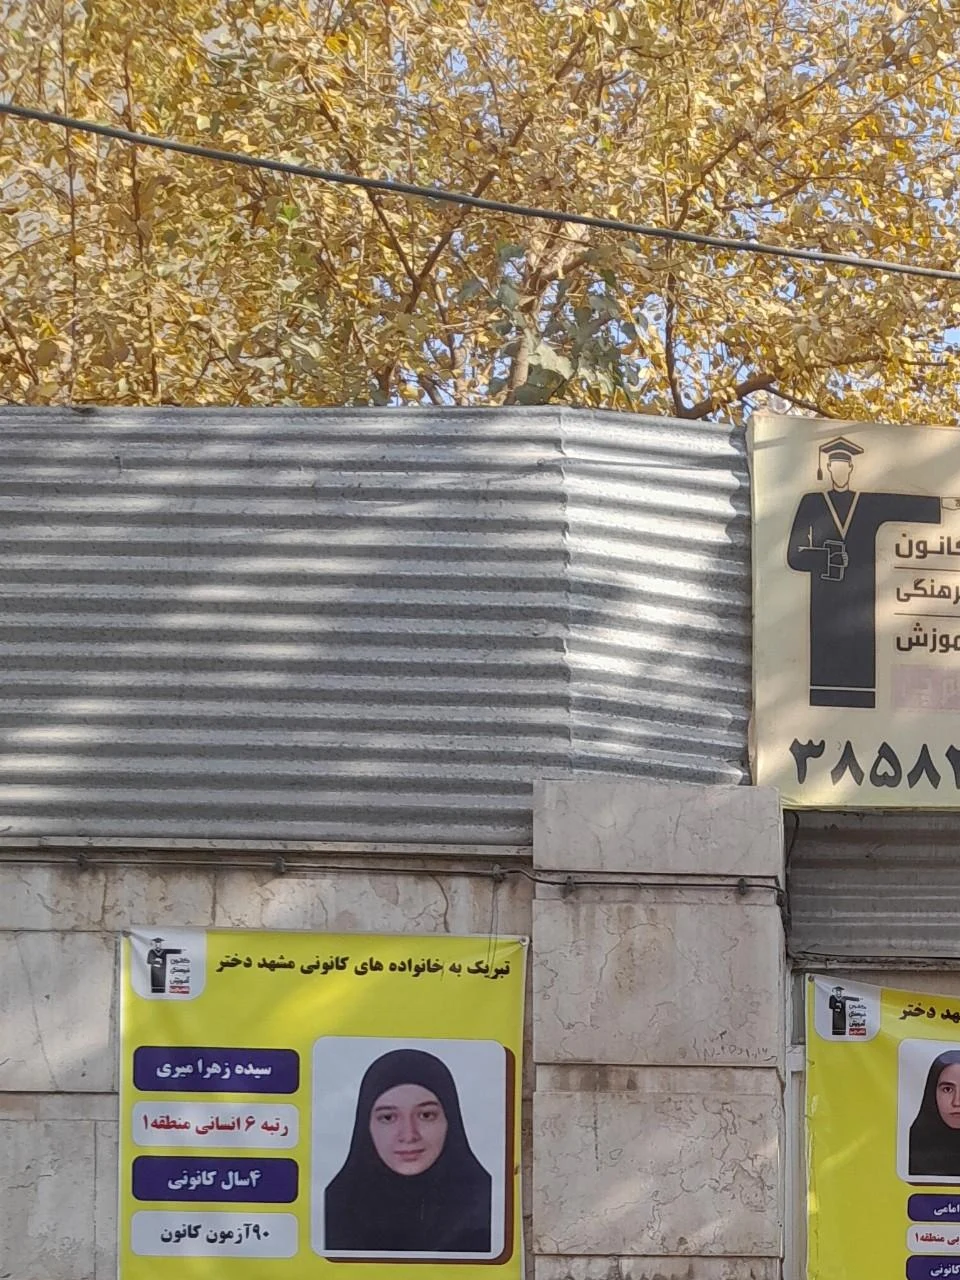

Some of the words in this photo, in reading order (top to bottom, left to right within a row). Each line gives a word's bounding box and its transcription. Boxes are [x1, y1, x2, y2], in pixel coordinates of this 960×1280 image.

[216, 953, 252, 972] دختر
[257, 955, 295, 971] مشهد
[300, 955, 349, 974] کانونی
[354, 957, 383, 975] های
[389, 958, 444, 977] خانواده
[449, 961, 462, 977] به
[467, 960, 510, 979] تبریک
[900, 1002, 936, 1020] دختر
[156, 1062, 193, 1078] میری
[198, 1059, 231, 1079] زهرا
[235, 1062, 271, 1079] سیده
[196, 1116, 241, 1135] انسانی
[245, 1116, 256, 1132] ۶
[261, 1118, 288, 1136] رتبه
[168, 1170, 217, 1190] کانونی
[934, 1203, 960, 1216] امامی
[160, 1224, 202, 1243] کانون
[930, 1264, 960, 1277] کانونی
